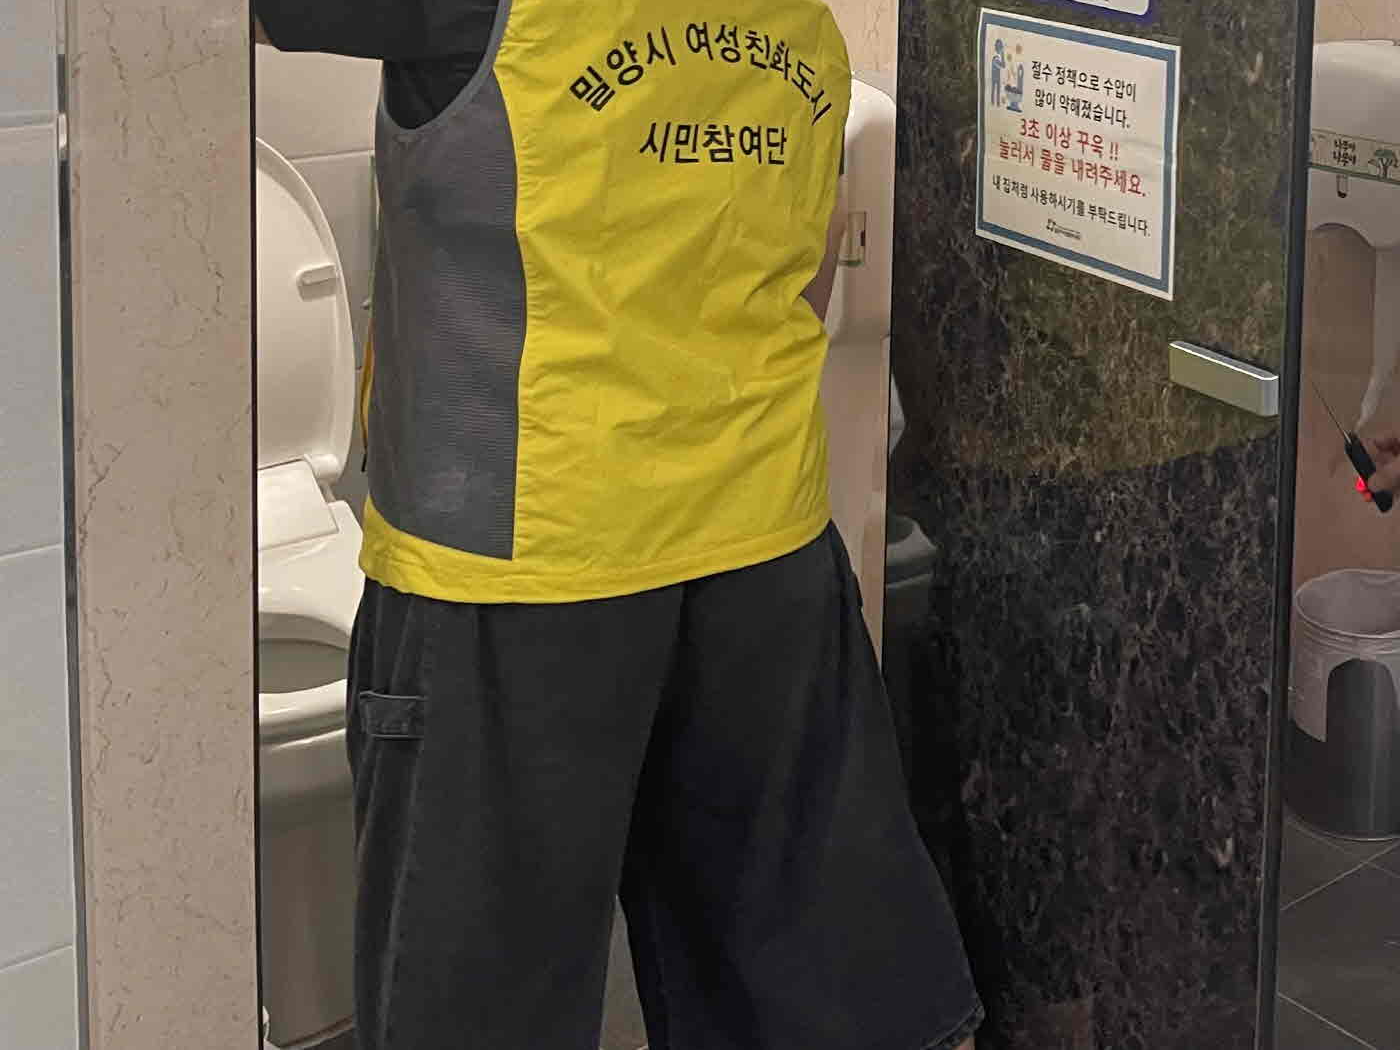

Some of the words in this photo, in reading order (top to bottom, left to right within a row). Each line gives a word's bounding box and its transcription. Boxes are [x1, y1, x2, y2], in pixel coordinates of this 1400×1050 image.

[569, 27, 677, 111] 밀양시
[685, 21, 832, 126] 여성친화도시
[1031, 61, 1053, 82] 절수
[1056, 66, 1100, 91] 정책으로
[1103, 78, 1136, 102] 수압이
[1035, 89, 1056, 110] 많이
[1059, 94, 1131, 128] 약해졌습니다.
[640, 121, 788, 165] 시민참여단
[1020, 118, 1041, 139] 3초
[1046, 124, 1071, 149] 이상
[1077, 130, 1104, 158] 꾸욱
[999, 139, 1034, 166] 눌러서
[1041, 149, 1065, 175] 물을
[1071, 158, 1146, 197] 내려주세요.
[1030, 187, 1085, 217] 사용하시기를
[1088, 204, 1150, 237] 부탁드립니다.
